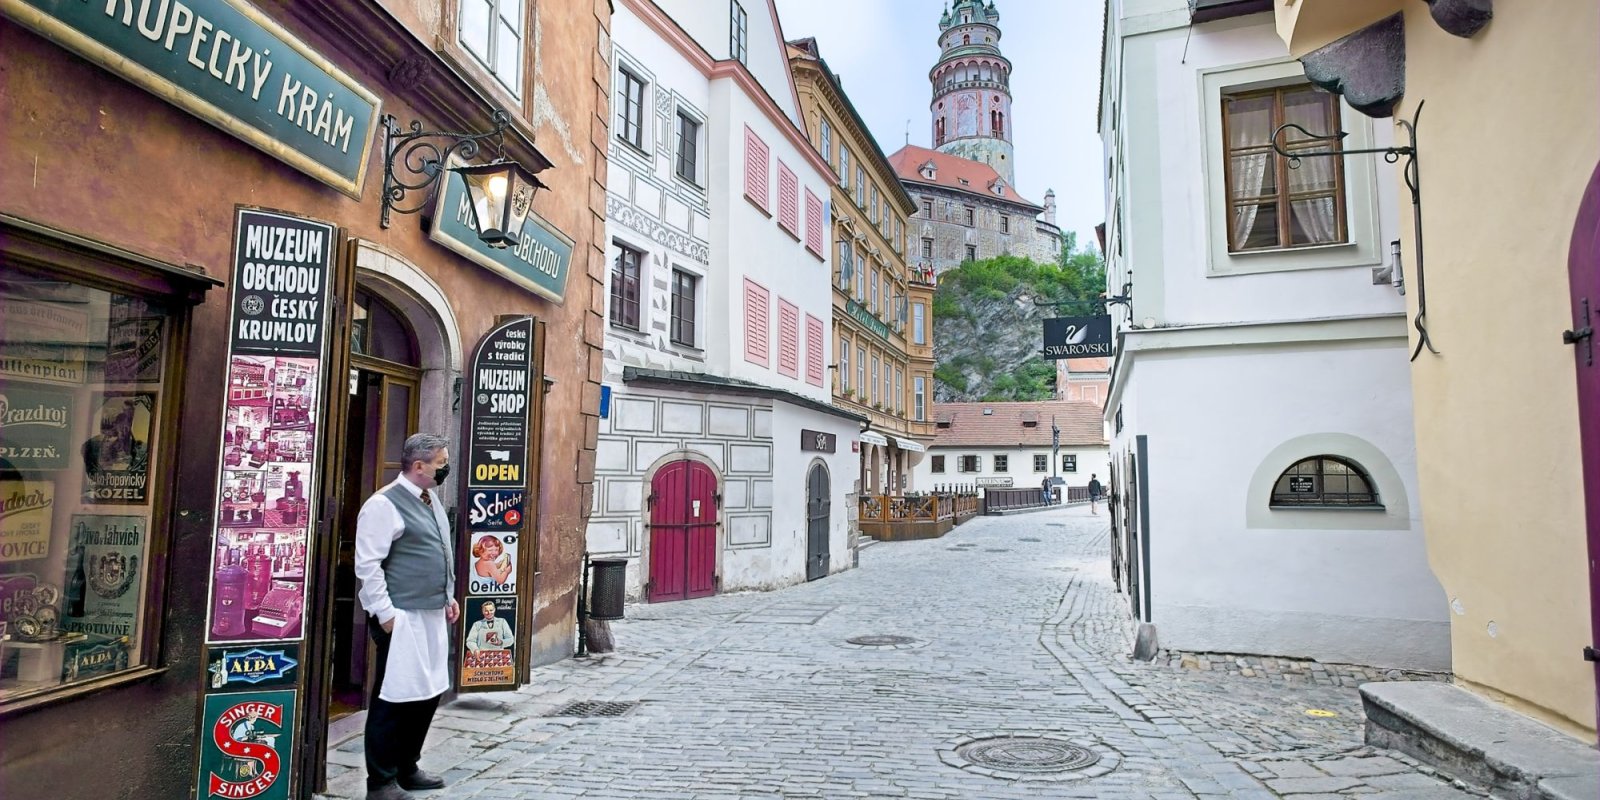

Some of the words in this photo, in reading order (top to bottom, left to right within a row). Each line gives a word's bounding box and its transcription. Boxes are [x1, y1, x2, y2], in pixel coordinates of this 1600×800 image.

[277, 73, 354, 153] KRÁM
[246, 224, 323, 264] MUZEUM
[242, 262, 320, 295] OBCHODU
[271, 294, 318, 320] ČESKÝ
[238, 319, 317, 343] KRUMLOV
[506, 329, 526, 339] české
[494, 340, 526, 350] výrobky
[1046, 343, 1109, 356] SWAROVSKI
[488, 352, 493, 360] s
[496, 352, 525, 361] tradicí
[479, 369, 526, 391] MUZEUM
[490, 393, 525, 413] SHOP
[475, 464, 519, 481] OPEN
[91, 488, 144, 499] KOZEL
[469, 492, 522, 525] Schicht
[471, 580, 516, 593] Oetker
[230, 655, 276, 673] ALPA
[220, 703, 276, 728] SINGER
[217, 771, 275, 797] SINGER
